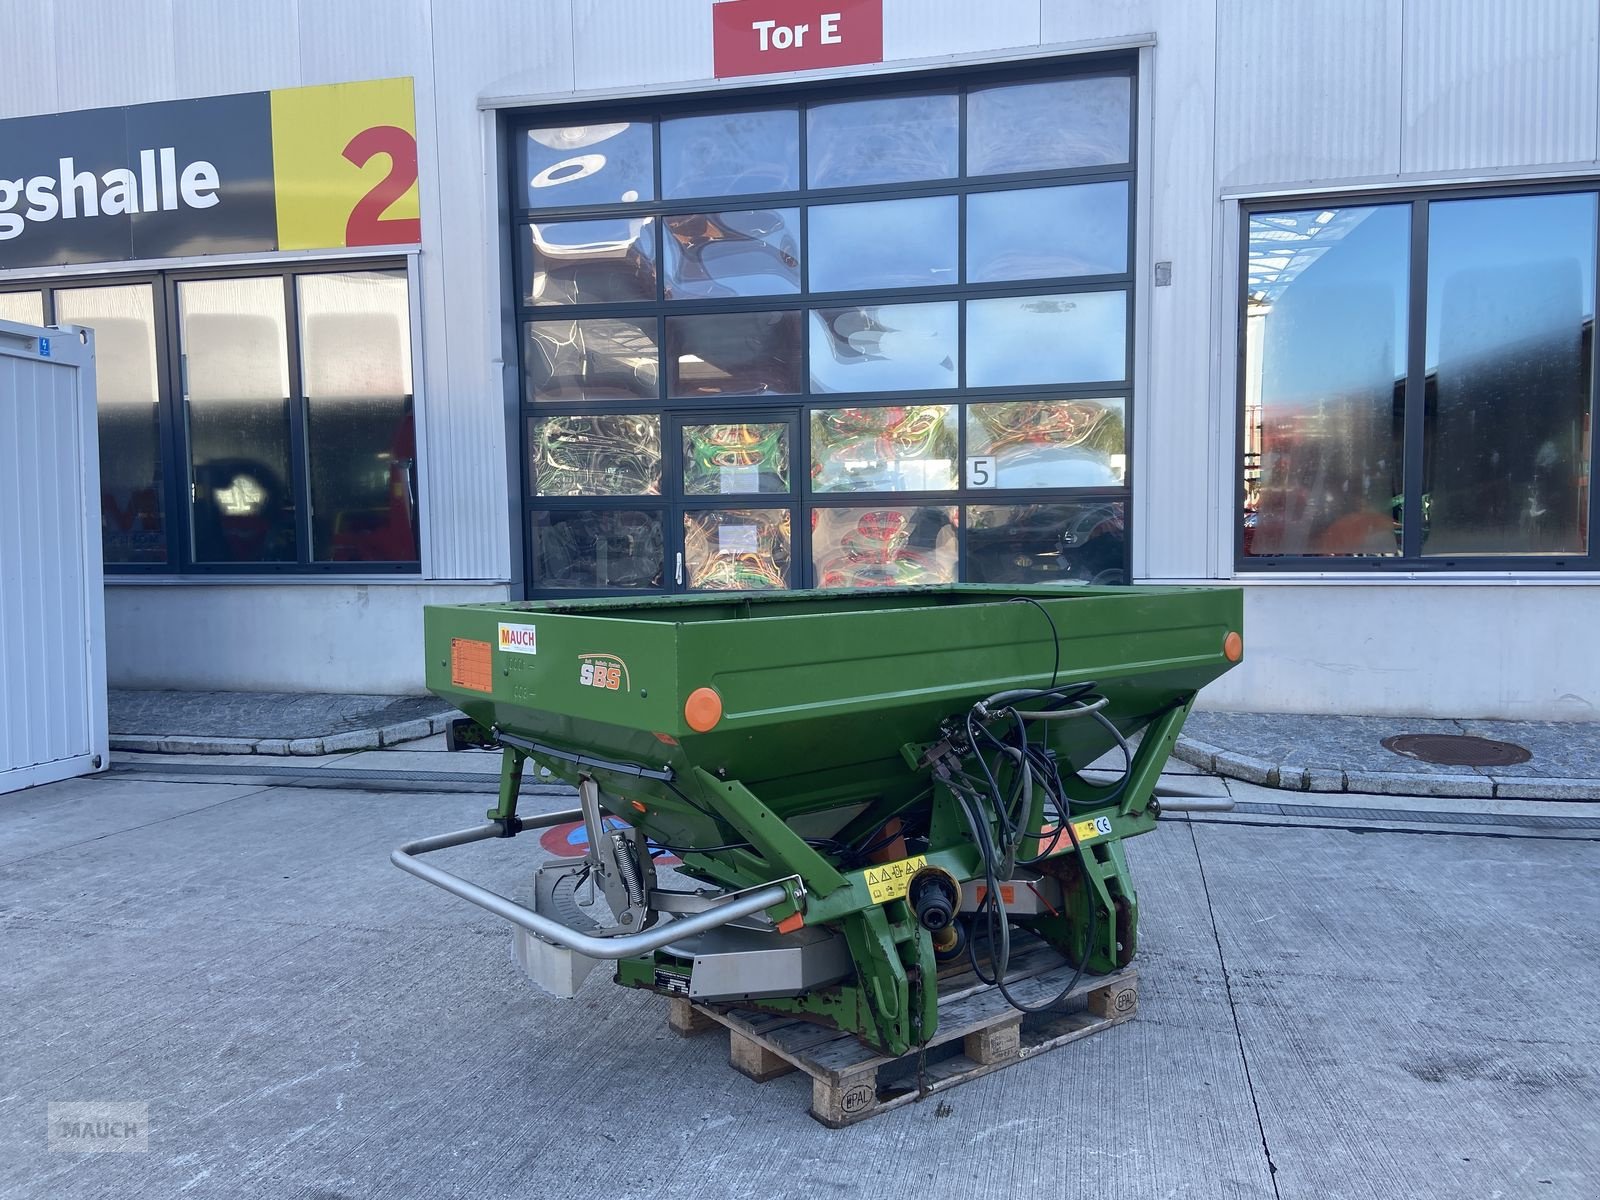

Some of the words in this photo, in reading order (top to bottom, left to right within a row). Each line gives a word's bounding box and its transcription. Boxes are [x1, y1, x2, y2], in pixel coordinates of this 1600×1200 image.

[752, 20, 809, 51] Tor
[820, 12, 842, 45] E
[0, 147, 220, 240] gshalle
[342, 125, 421, 247] 2
[973, 460, 989, 486] 5
[501, 629, 535, 647] MAUCH
[580, 663, 621, 690] SBS
[1118, 992, 1134, 1009] EPAL
